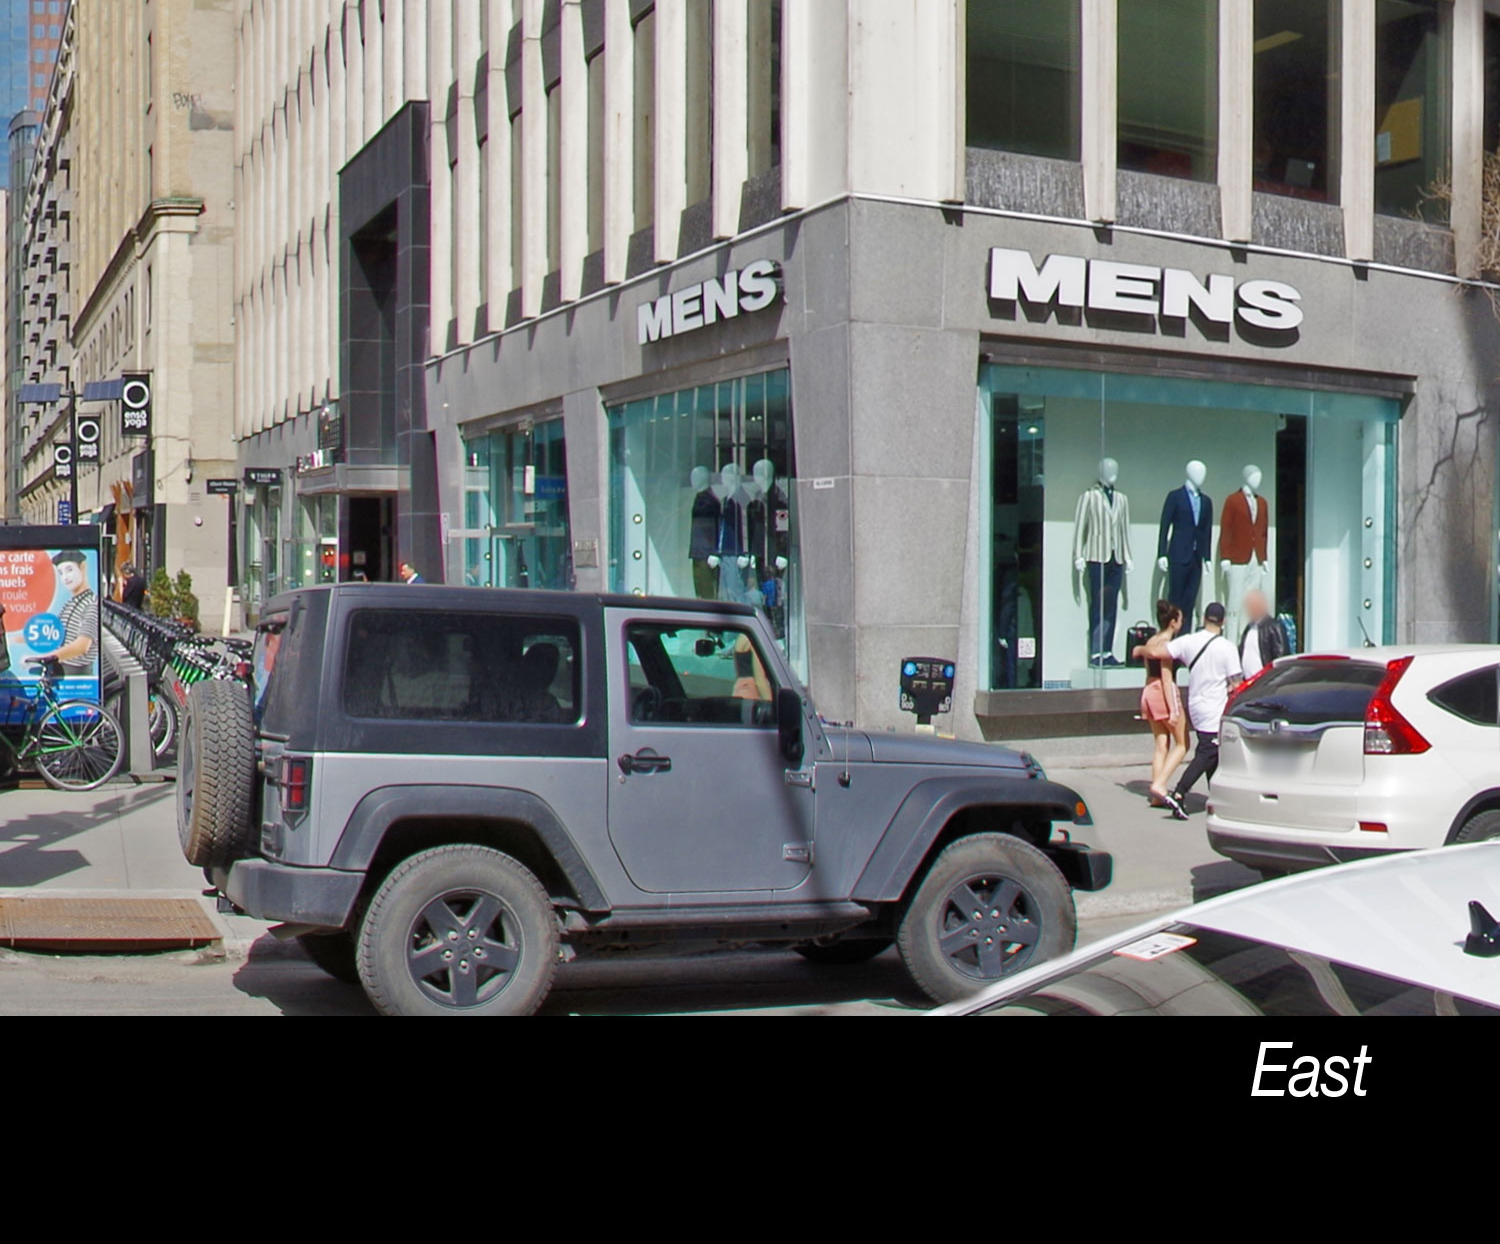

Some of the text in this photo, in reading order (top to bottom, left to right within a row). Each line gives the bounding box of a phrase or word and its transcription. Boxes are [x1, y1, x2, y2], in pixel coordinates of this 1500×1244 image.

[990, 246, 1304, 330] MENS
[637, 259, 777, 345] MENS
[123, 418, 148, 429] yoga
[8, 552, 35, 563] carte
[10, 563, 35, 576] frais
[2, 589, 29, 601] roule
[9, 602, 37, 613] vous!
[28, 624, 60, 641] 5 %
